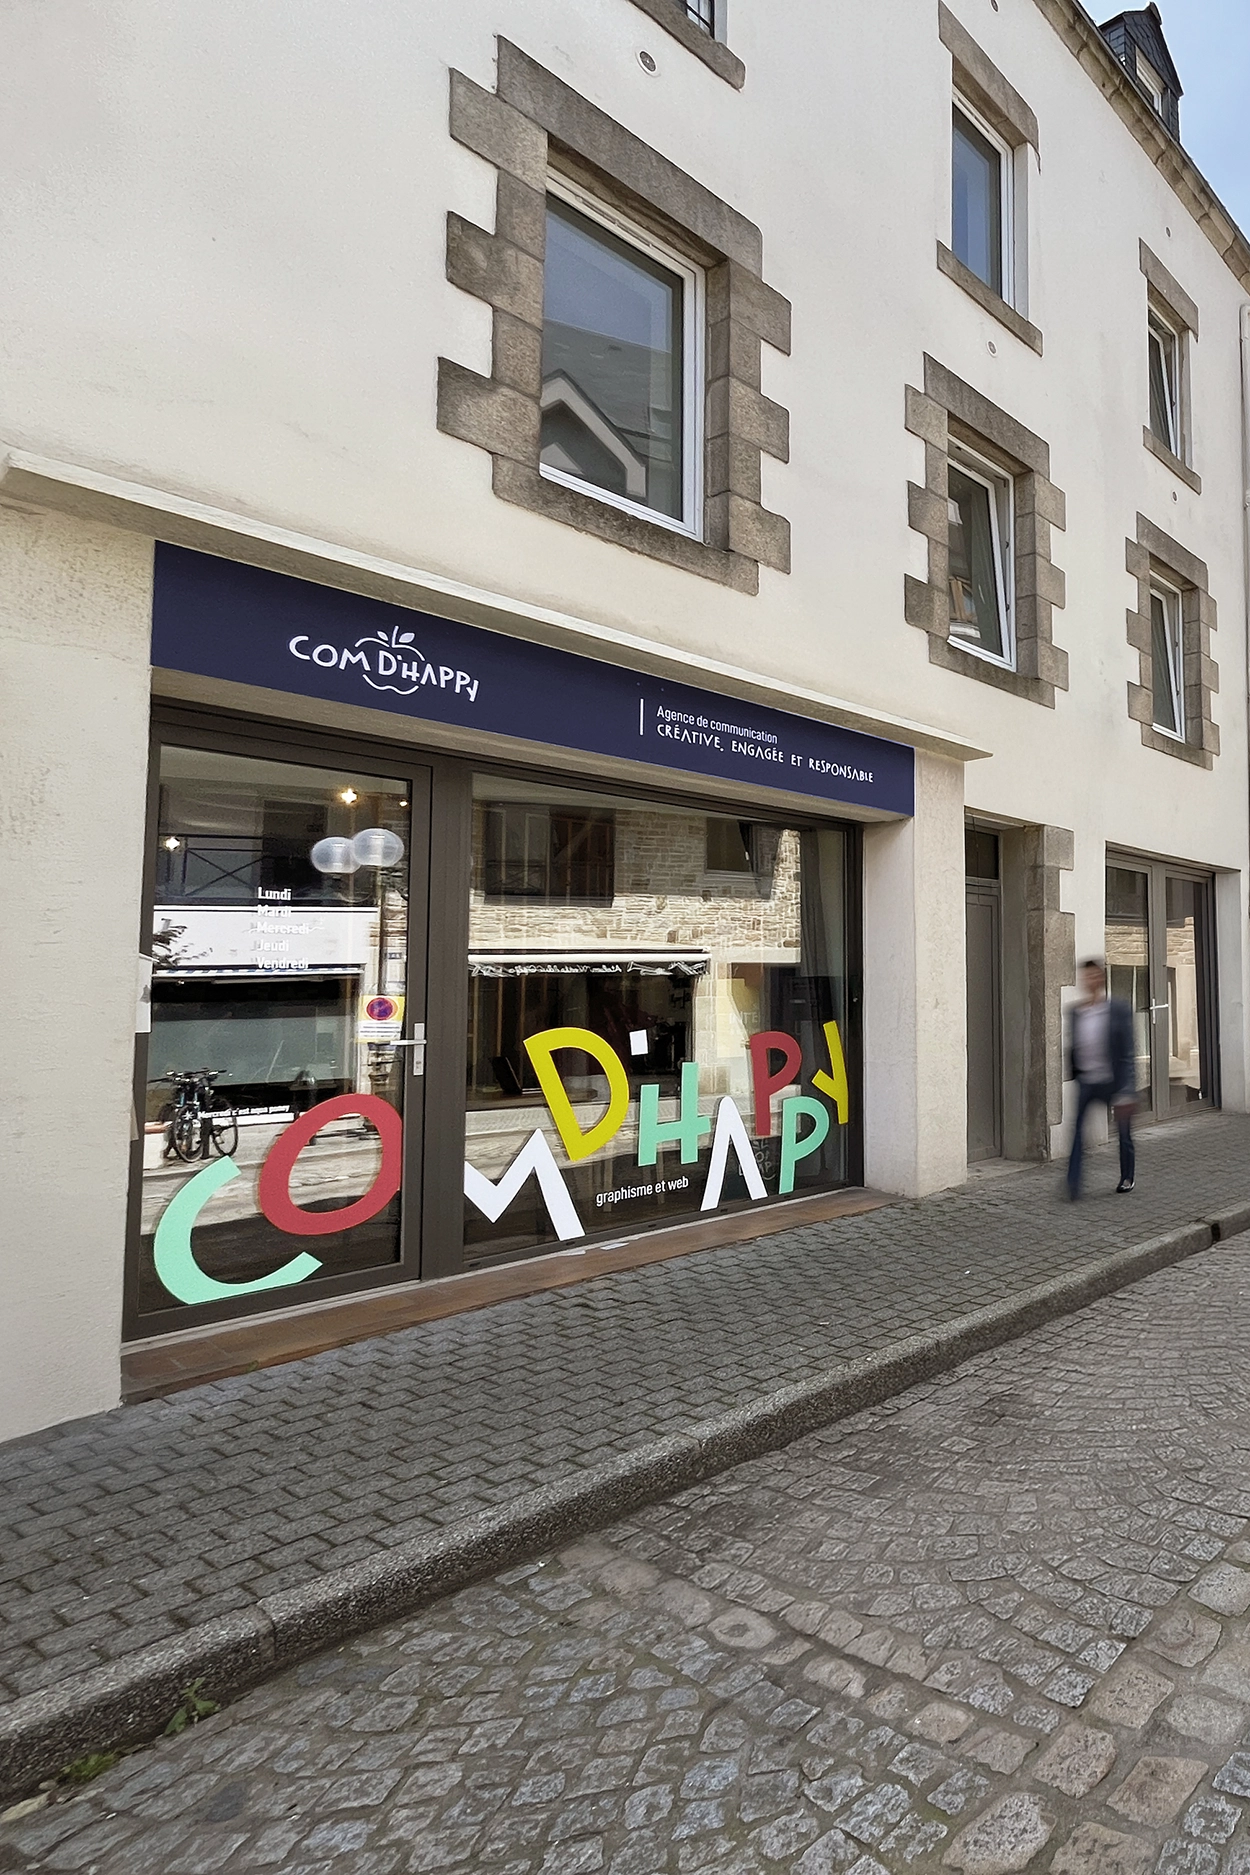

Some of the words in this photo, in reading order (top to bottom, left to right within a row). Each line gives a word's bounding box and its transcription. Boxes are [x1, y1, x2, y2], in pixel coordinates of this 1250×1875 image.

[288, 635, 371, 670] COM
[656, 705, 695, 725] Agence
[696, 715, 708, 729] de
[710, 719, 778, 744] communication
[731, 740, 784, 763] ENGAGÉE
[791, 754, 804, 767] ET
[808, 757, 874, 783] RESPONSABLE
[257, 886, 291, 901] Lundi
[257, 904, 291, 918] Mardi
[257, 921, 309, 935] Mercredi
[257, 939, 289, 952] Jeudi
[257, 956, 309, 969] Vendredi
[153, 1093, 586, 1304] COM
[596, 1183, 653, 1207] graphisme
[655, 1180, 665, 1193] et
[667, 1175, 689, 1191] web
